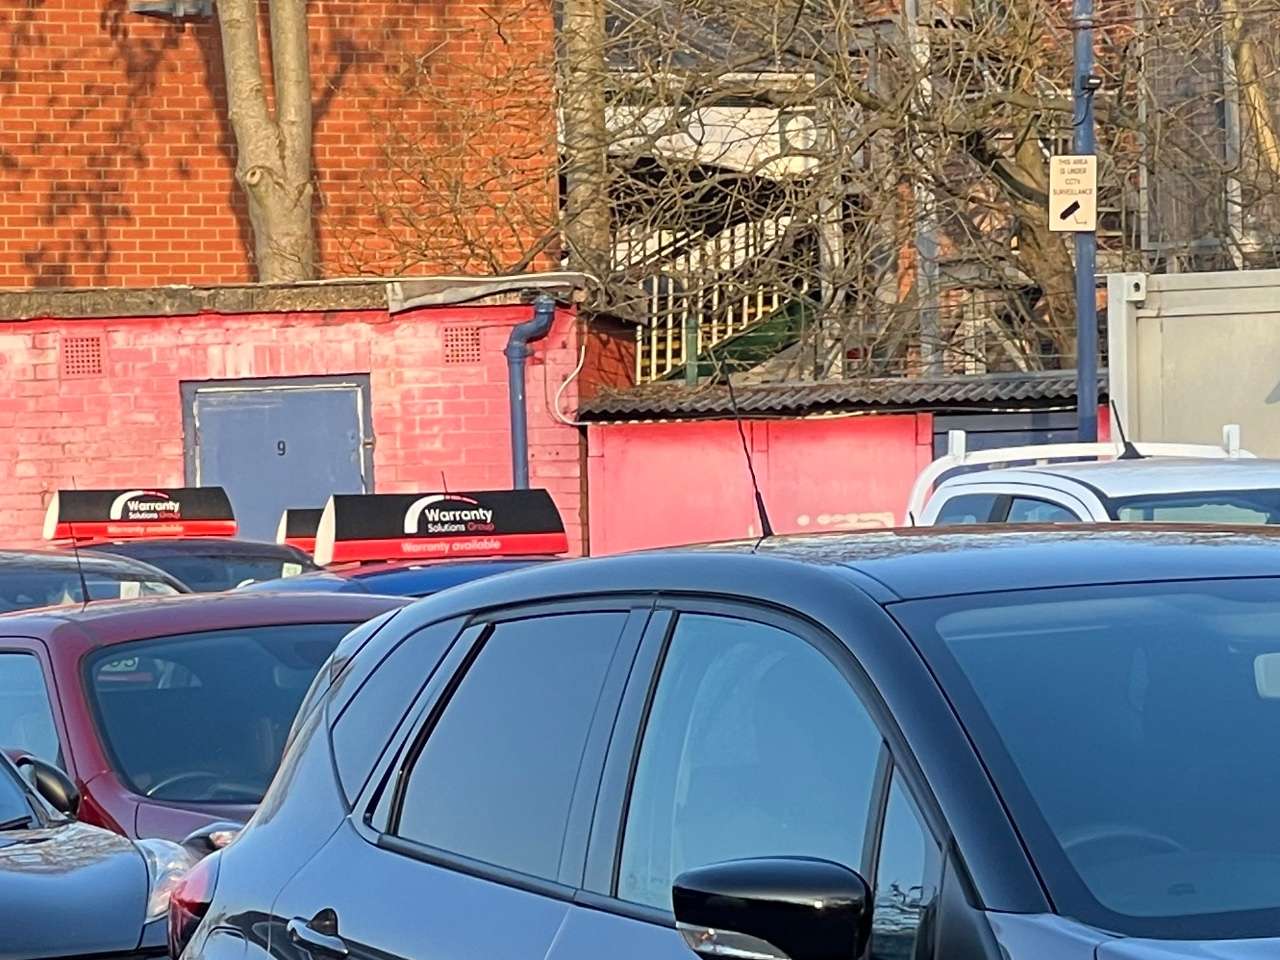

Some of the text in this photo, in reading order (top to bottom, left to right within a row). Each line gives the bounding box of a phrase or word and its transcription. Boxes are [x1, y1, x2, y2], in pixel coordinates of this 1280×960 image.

[277, 440, 286, 456] 9
[127, 501, 180, 512] Warranty
[425, 508, 492, 523] Warranty
[427, 522, 494, 532] Solutions Group
[401, 540, 502, 554] Warranty available
